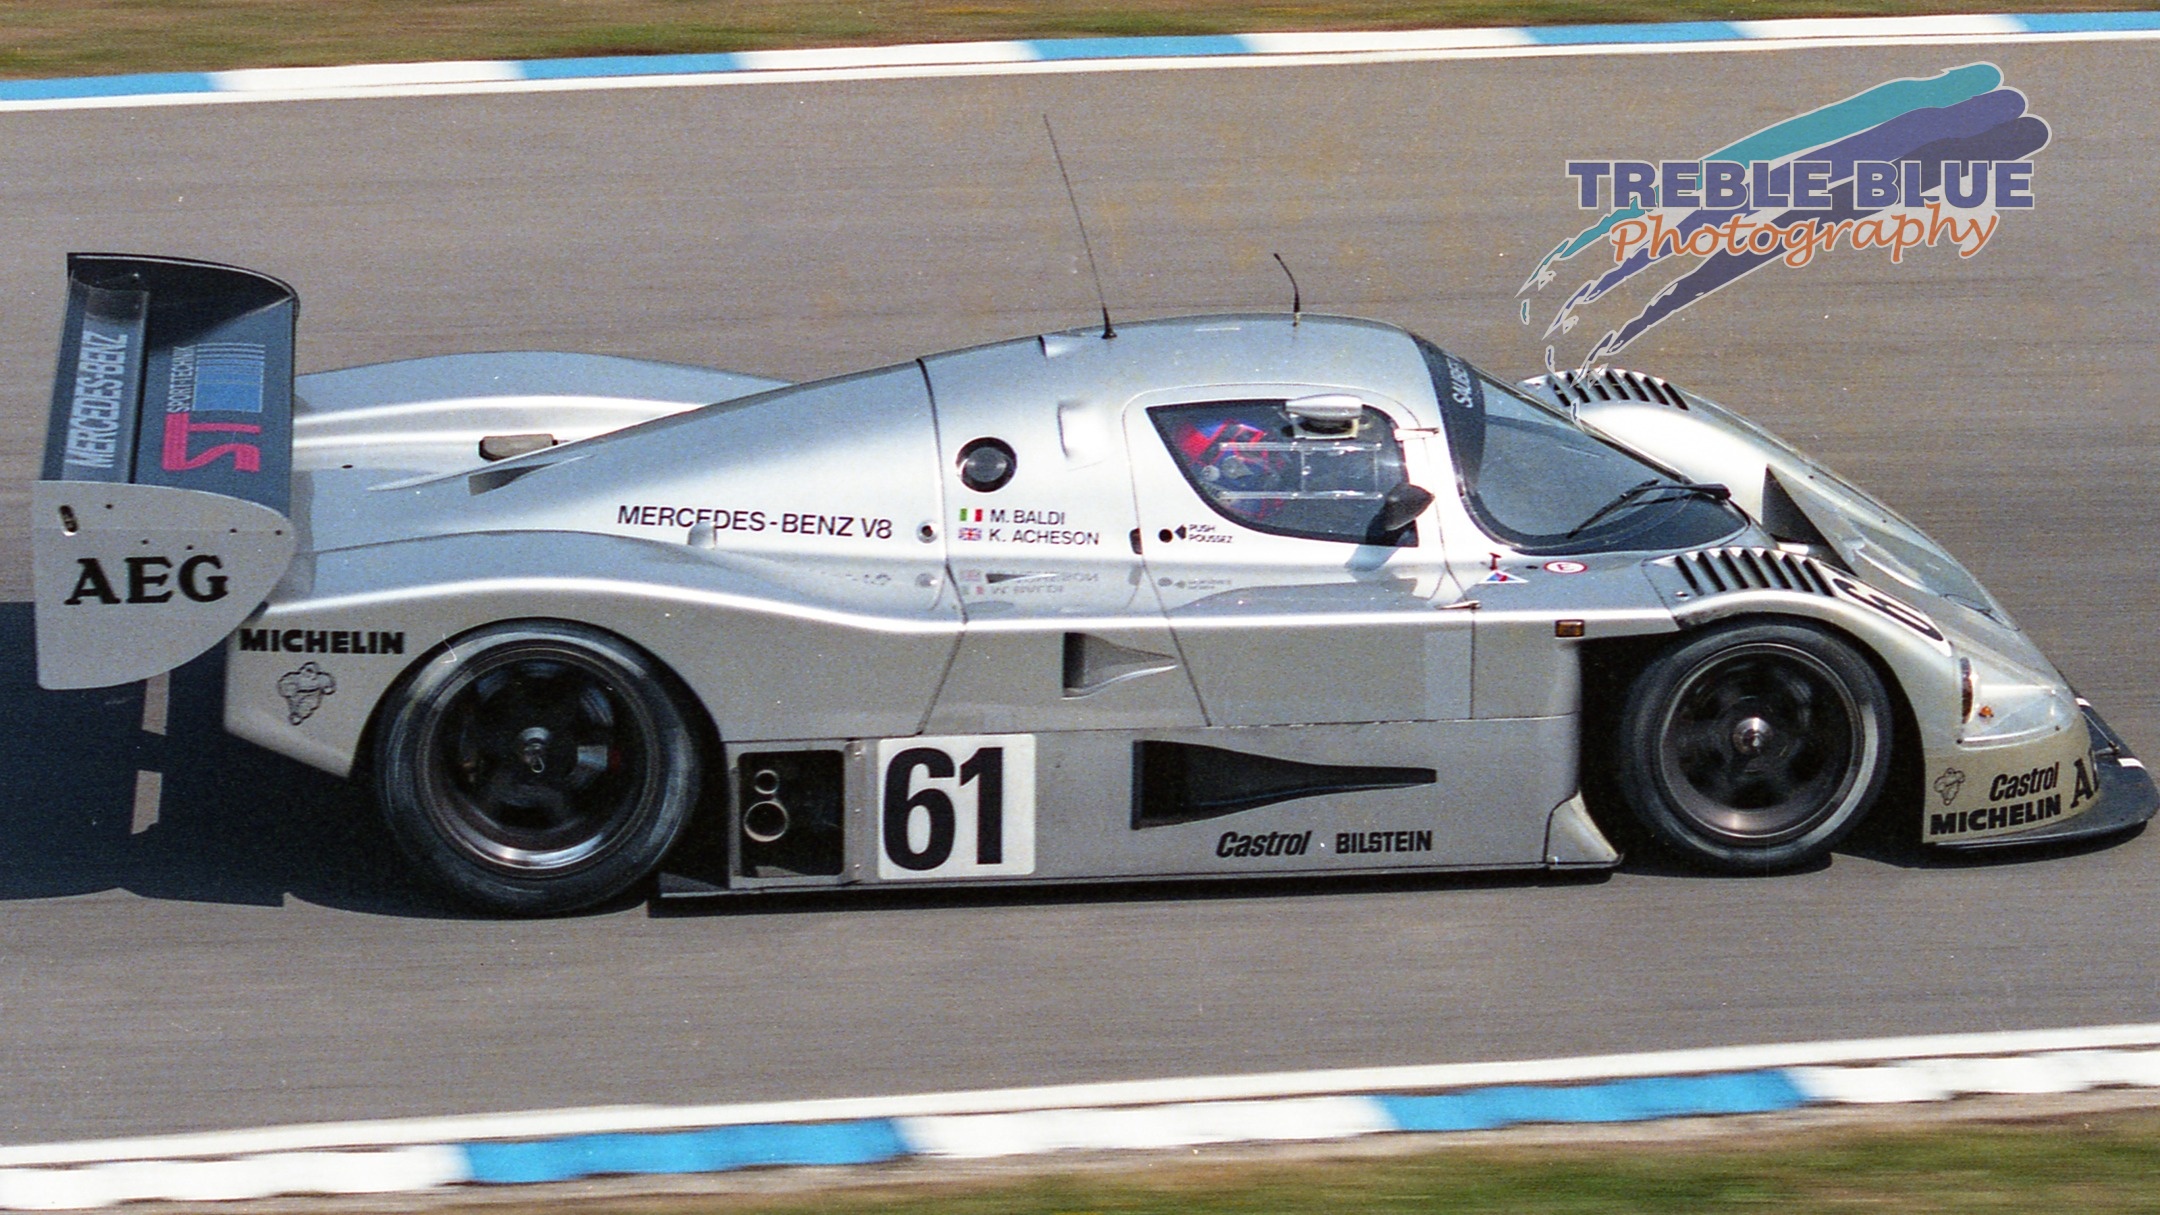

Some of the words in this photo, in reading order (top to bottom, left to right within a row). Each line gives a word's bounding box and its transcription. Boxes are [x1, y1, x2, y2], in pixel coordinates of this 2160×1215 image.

[64, 330, 128, 469] MERCEDES-BENZ
[617, 505, 853, 537] MERCEDES-BENZ
[861, 517, 893, 540] V8
[990, 508, 1010, 523] M.
[1013, 509, 1065, 525] BALDI
[1189, 523, 1216, 533] PUSH
[989, 528, 1007, 542] K.
[1012, 529, 1099, 545] ACHESON
[64, 554, 229, 605] AEG
[239, 628, 404, 655] MICHELIN
[1989, 761, 2060, 802] Castrol
[883, 747, 1003, 871] 61
[1930, 793, 2061, 836] MICHELIN
[1216, 830, 1313, 857] Castrol
[1336, 830, 1433, 854] BILSTEIN
